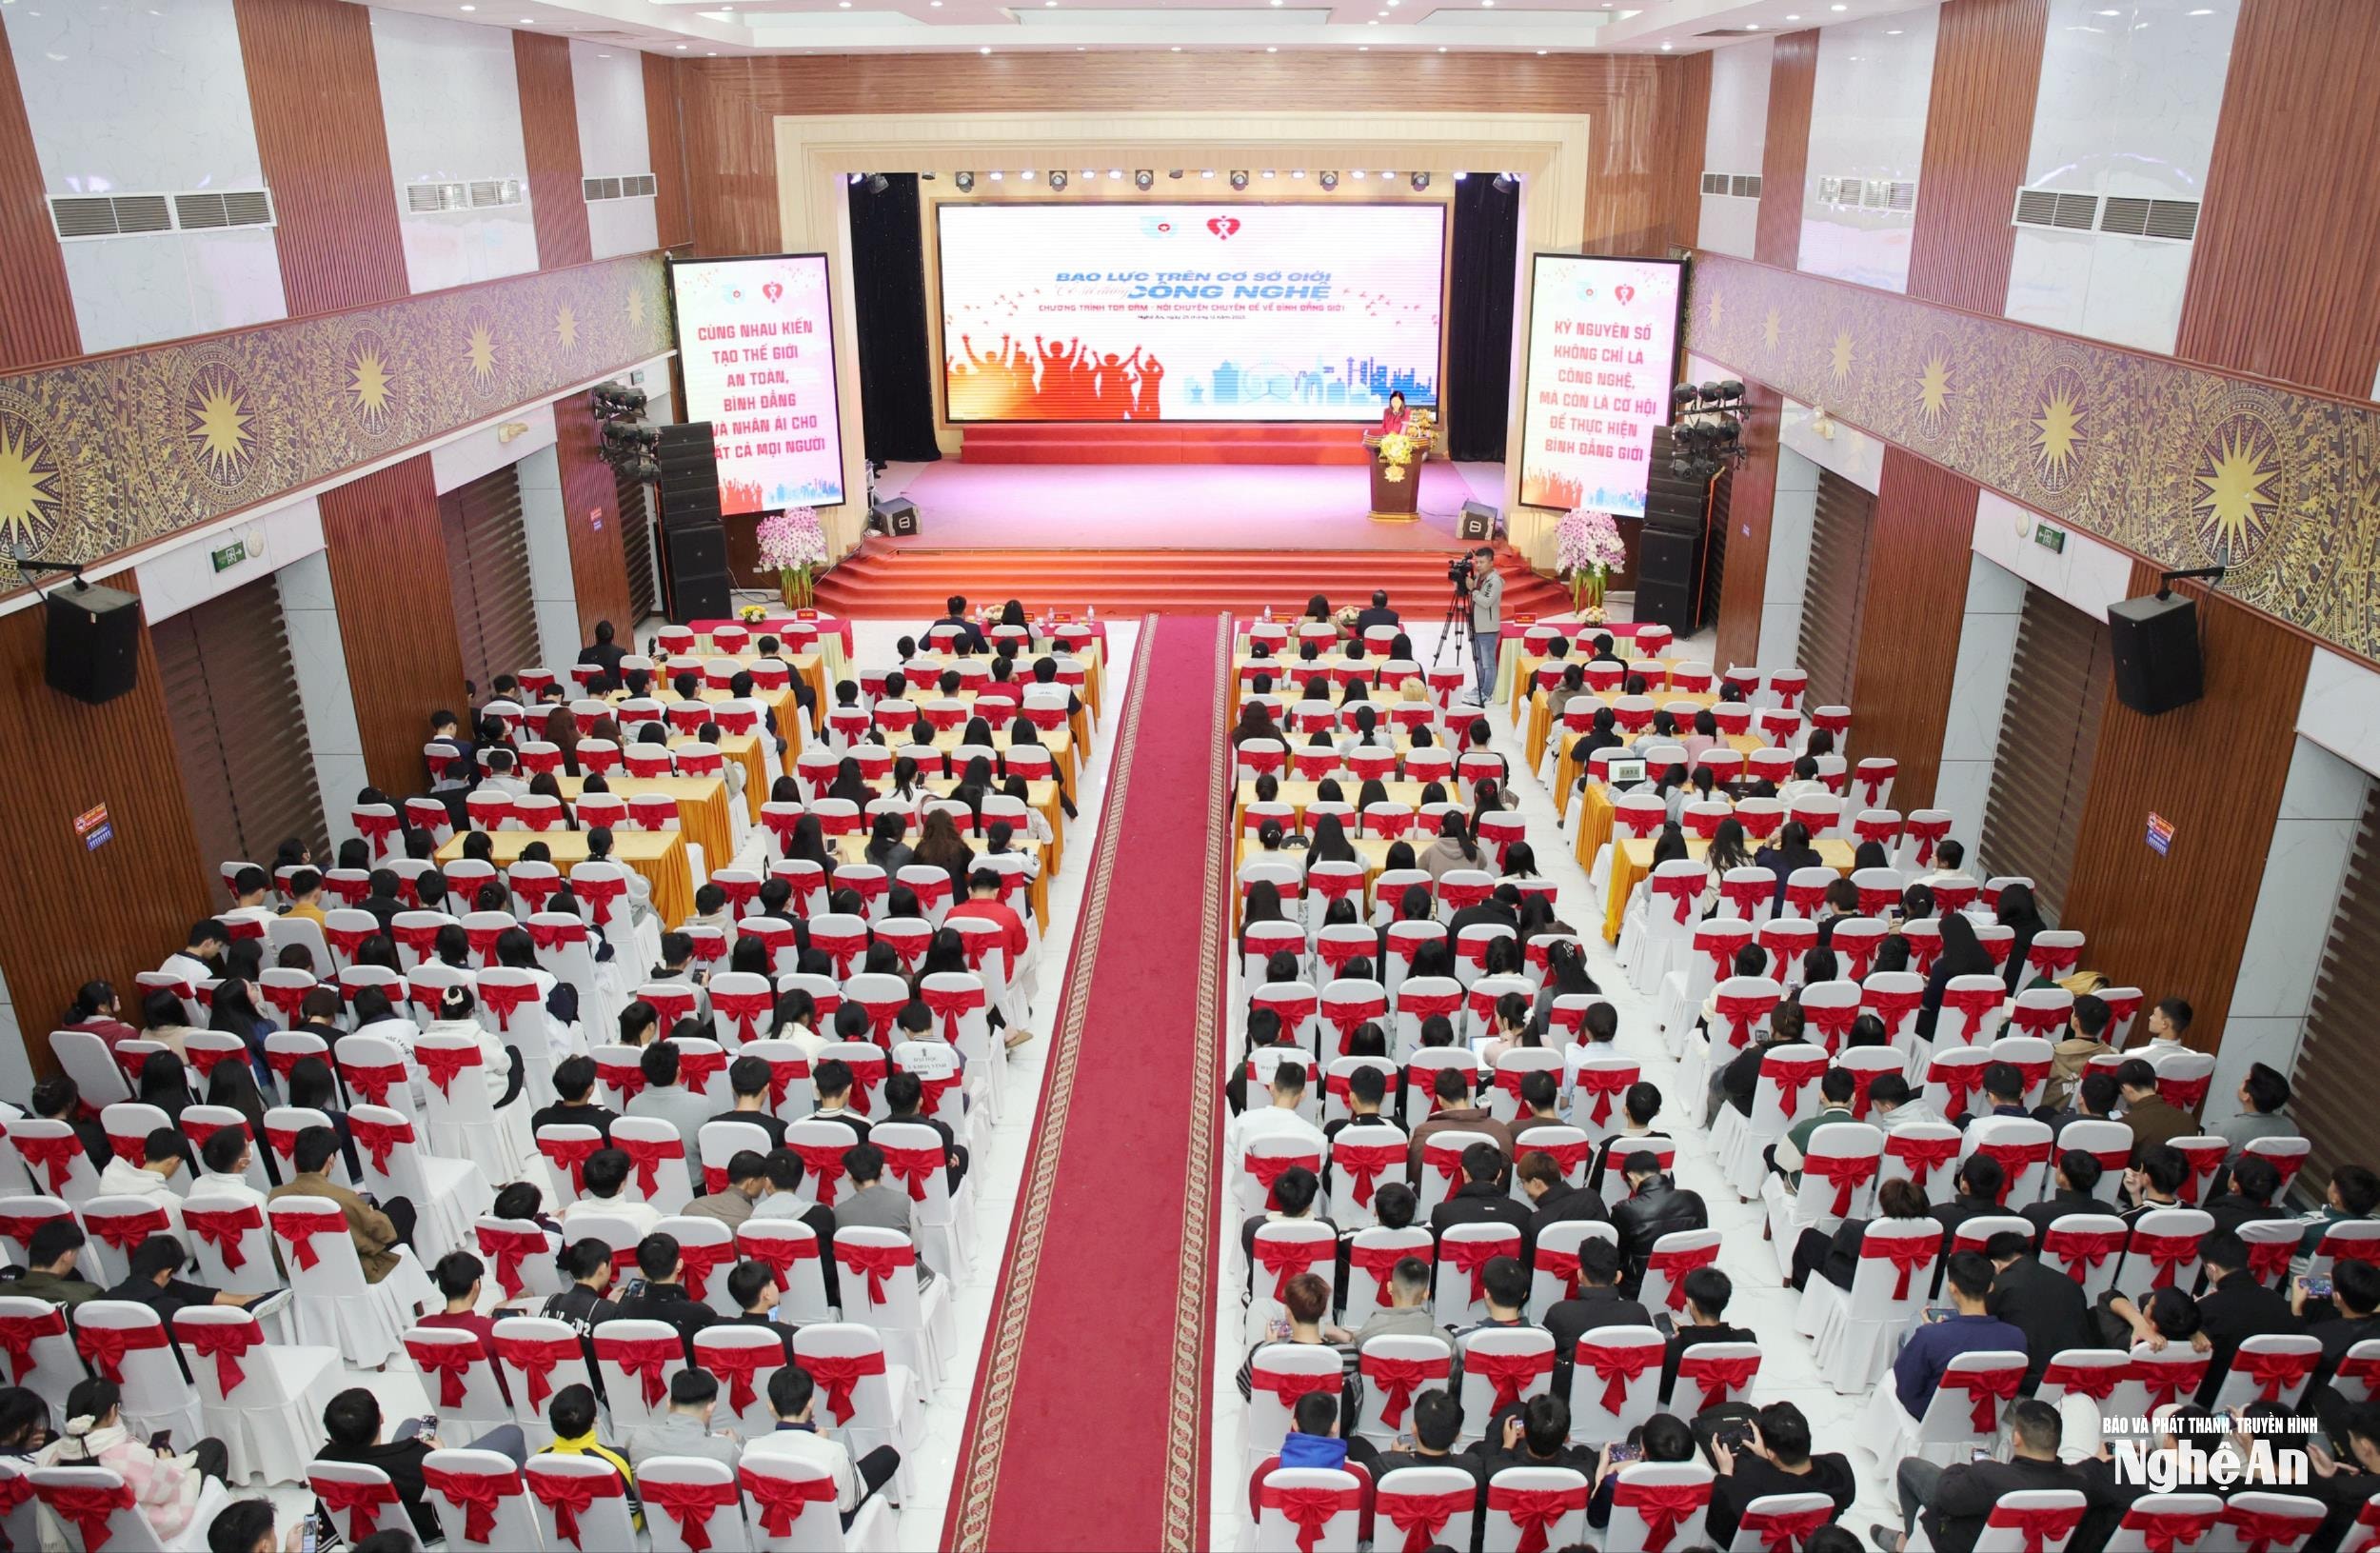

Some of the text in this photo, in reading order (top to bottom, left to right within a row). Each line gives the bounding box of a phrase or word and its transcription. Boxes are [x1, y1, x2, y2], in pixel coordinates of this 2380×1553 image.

[1234, 281, 1331, 301] NGHỆ
[698, 317, 812, 341] CÙNG NHAU KIẾN
[1577, 322, 1629, 338] NGUYÊN
[1634, 323, 1652, 340] SỐ
[712, 344, 798, 367] TẠO THẾ GIỚI
[1554, 345, 1597, 361] KHÔNG
[1628, 349, 1644, 364] LÀ
[727, 370, 789, 387] AN TOÀN,
[1559, 369, 1635, 390] CÔNG NGHỆ,
[724, 396, 756, 412] BÌNH
[1540, 391, 1656, 416] MÀ CÒN LÀ CƠ HỘI
[733, 417, 770, 435] NHÂN
[775, 417, 787, 431] ÁI
[792, 415, 817, 430] CHO
[1571, 417, 1602, 435] THỰC
[1607, 420, 1637, 438] HIỆN
[715, 437, 825, 460] ẤT CẢ MỌI NGƯỜI
[1545, 438, 1576, 454] BÌNH
[1618, 445, 1643, 461] GIỚI
